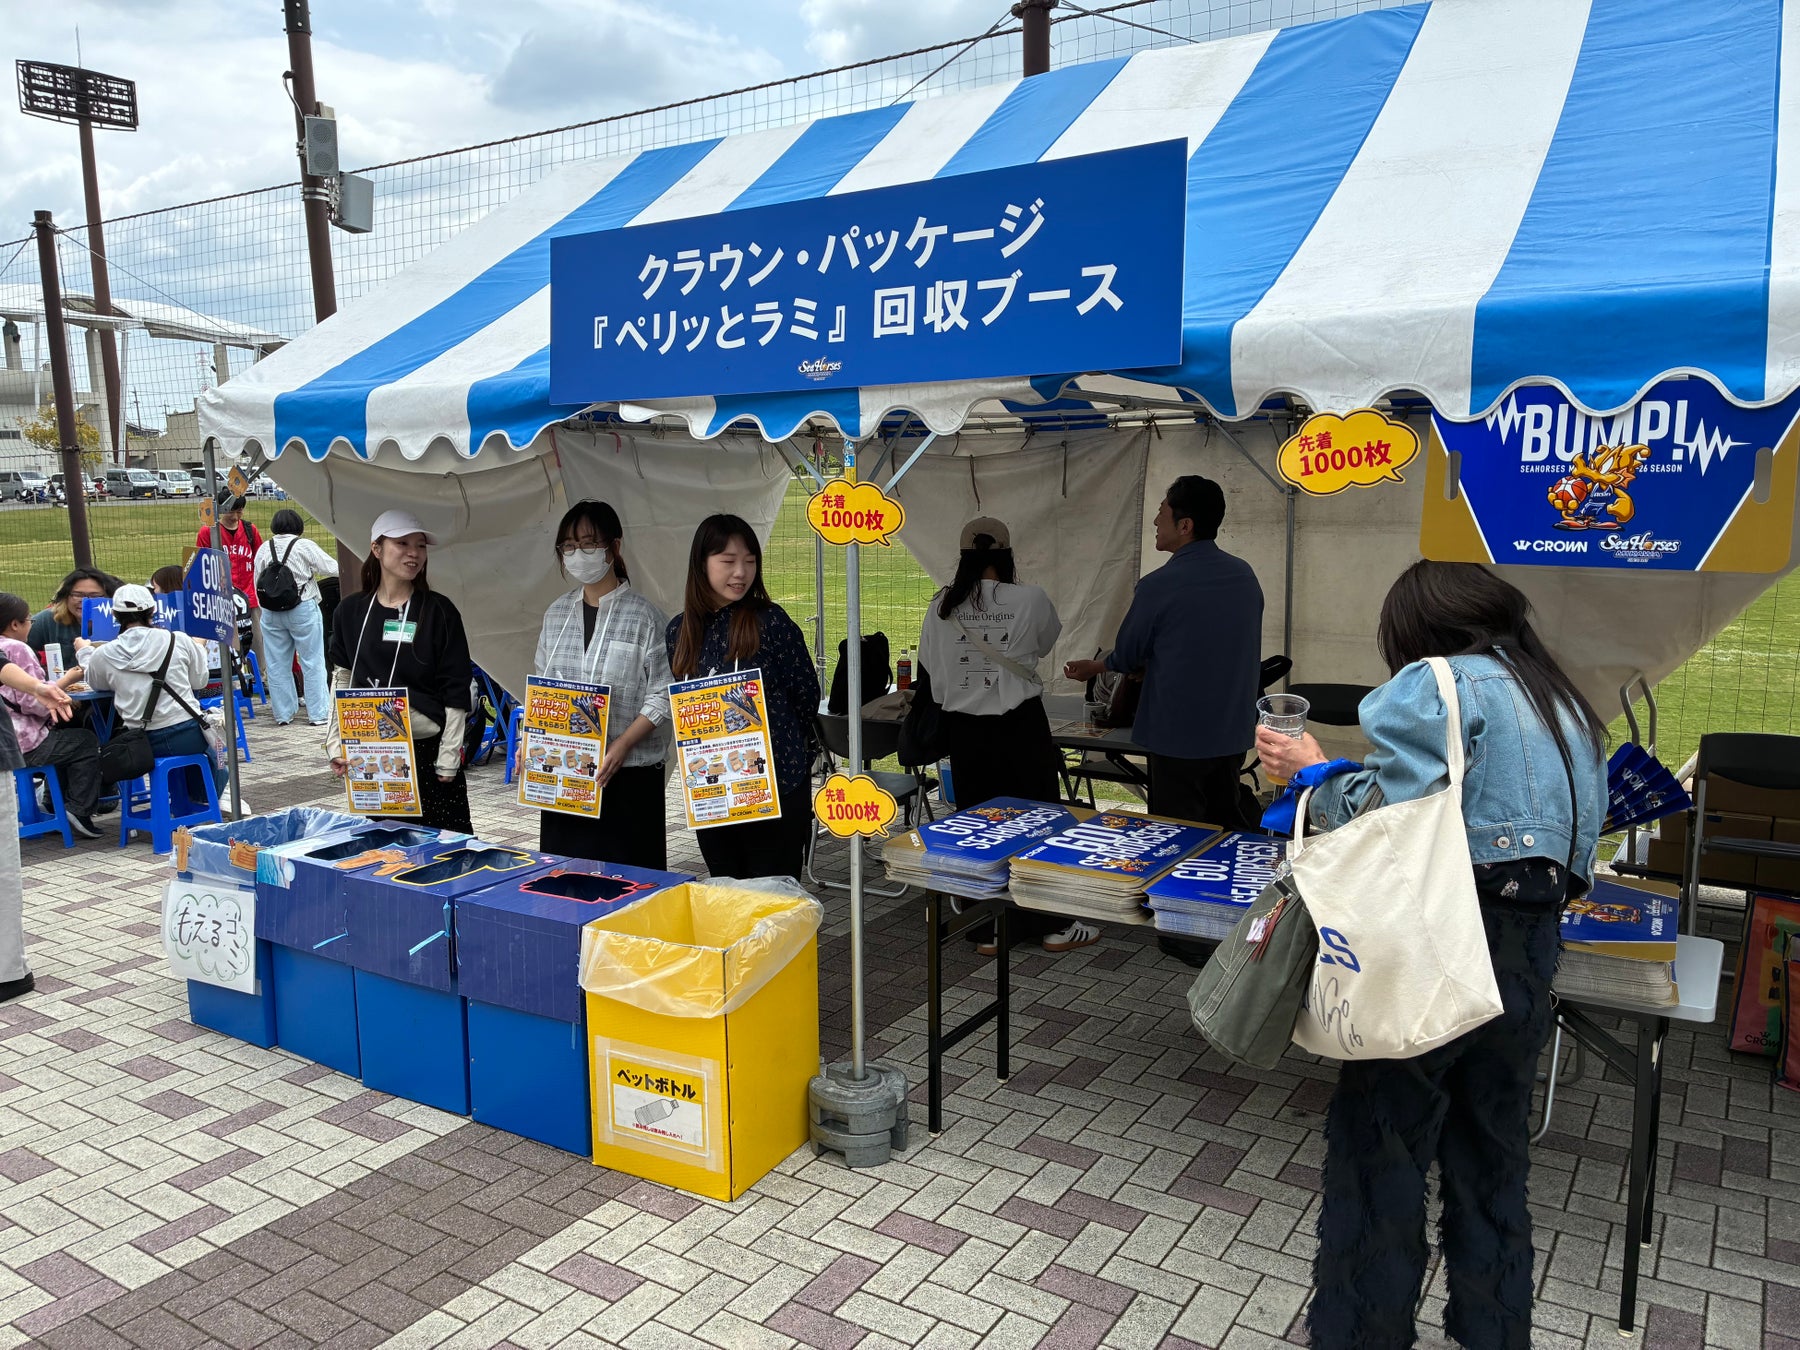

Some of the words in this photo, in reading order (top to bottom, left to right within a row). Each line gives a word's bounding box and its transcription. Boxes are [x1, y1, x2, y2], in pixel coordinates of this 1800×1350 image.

[638, 197, 1046, 299] クラウン・パッケージ
[1521, 400, 1688, 463] BUMP!
[1298, 431, 1332, 454] 先着
[1300, 439, 1393, 477] 1000枚
[1520, 464, 1566, 474] SEAHORSES
[1650, 464, 1683, 473] SEASON
[821, 494, 845, 509] 先着
[821, 509, 885, 531] 1000枚
[1532, 539, 1588, 553] CROWN
[201, 553, 222, 591] GO!
[956, 611, 980, 621] eline
[981, 611, 1015, 622] Origins
[678, 700, 721, 718] オリジナル
[680, 711, 722, 730] ハリセン
[825, 788, 846, 803] 先着
[826, 801, 881, 822] 1000枚
[928, 815, 997, 836] GO!
[1171, 858, 1231, 882] GO!
[617, 1069, 696, 1100] ペットボトル
